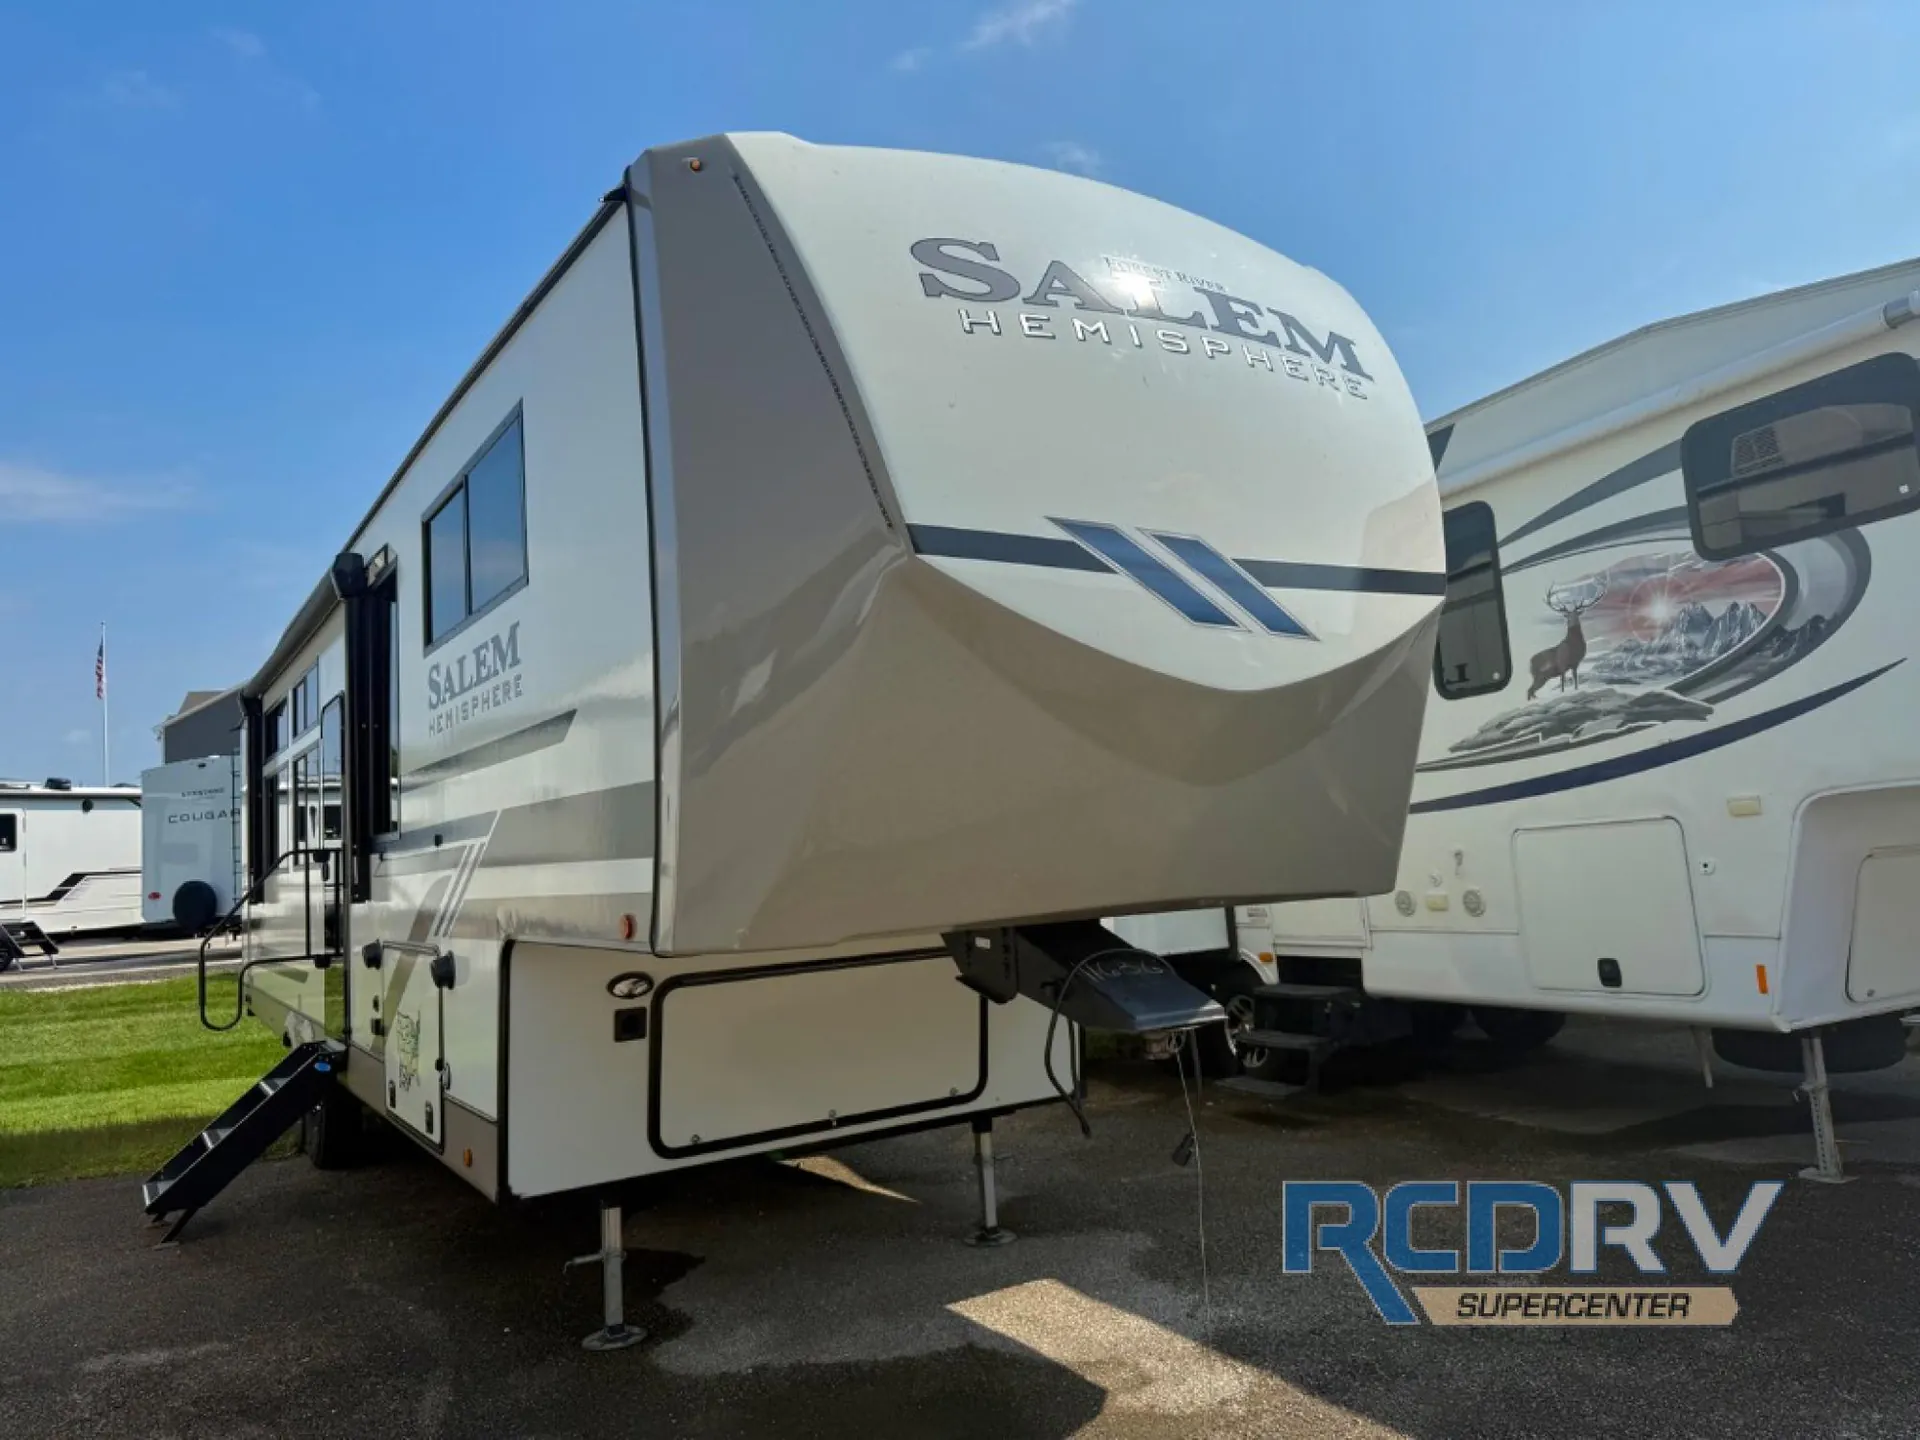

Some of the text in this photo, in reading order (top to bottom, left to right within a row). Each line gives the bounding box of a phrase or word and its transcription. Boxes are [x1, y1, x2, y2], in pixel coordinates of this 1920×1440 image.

[910, 237, 1374, 382] SALEM
[957, 307, 1369, 401] HEMISPHERE
[428, 620, 522, 711] SALEM
[429, 673, 523, 738] HEMISPHERE
